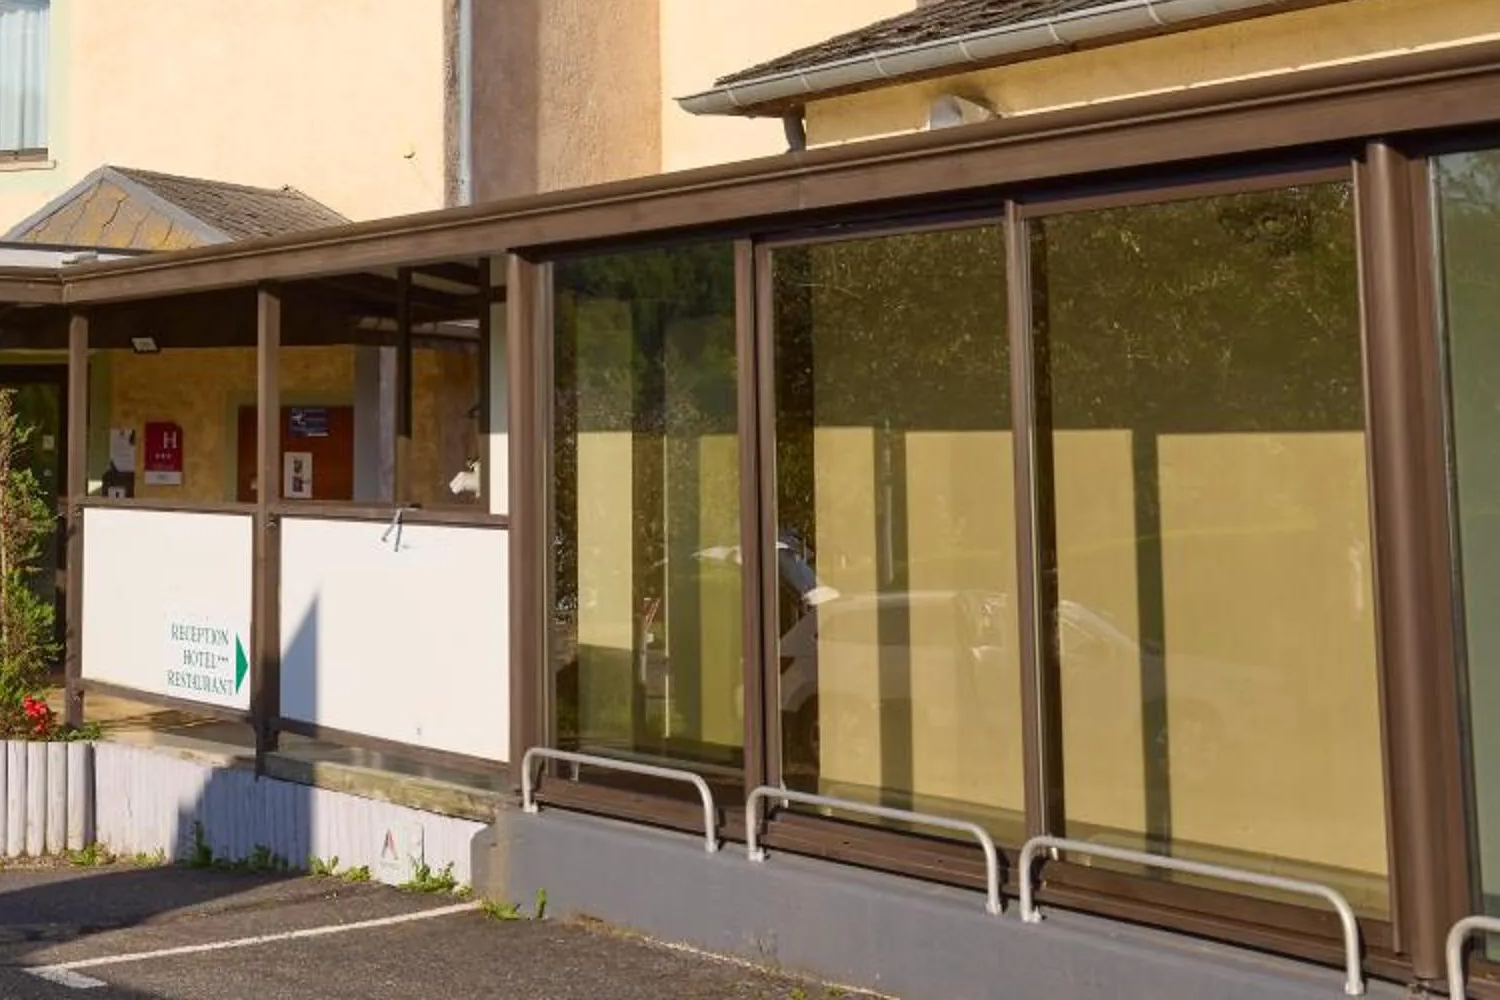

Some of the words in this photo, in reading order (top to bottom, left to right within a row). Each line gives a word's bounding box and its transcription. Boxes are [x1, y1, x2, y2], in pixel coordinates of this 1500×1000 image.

[163, 430, 177, 449] H
[171, 623, 229, 645] RECEPTION
[167, 669, 233, 696] RESTAURANT
